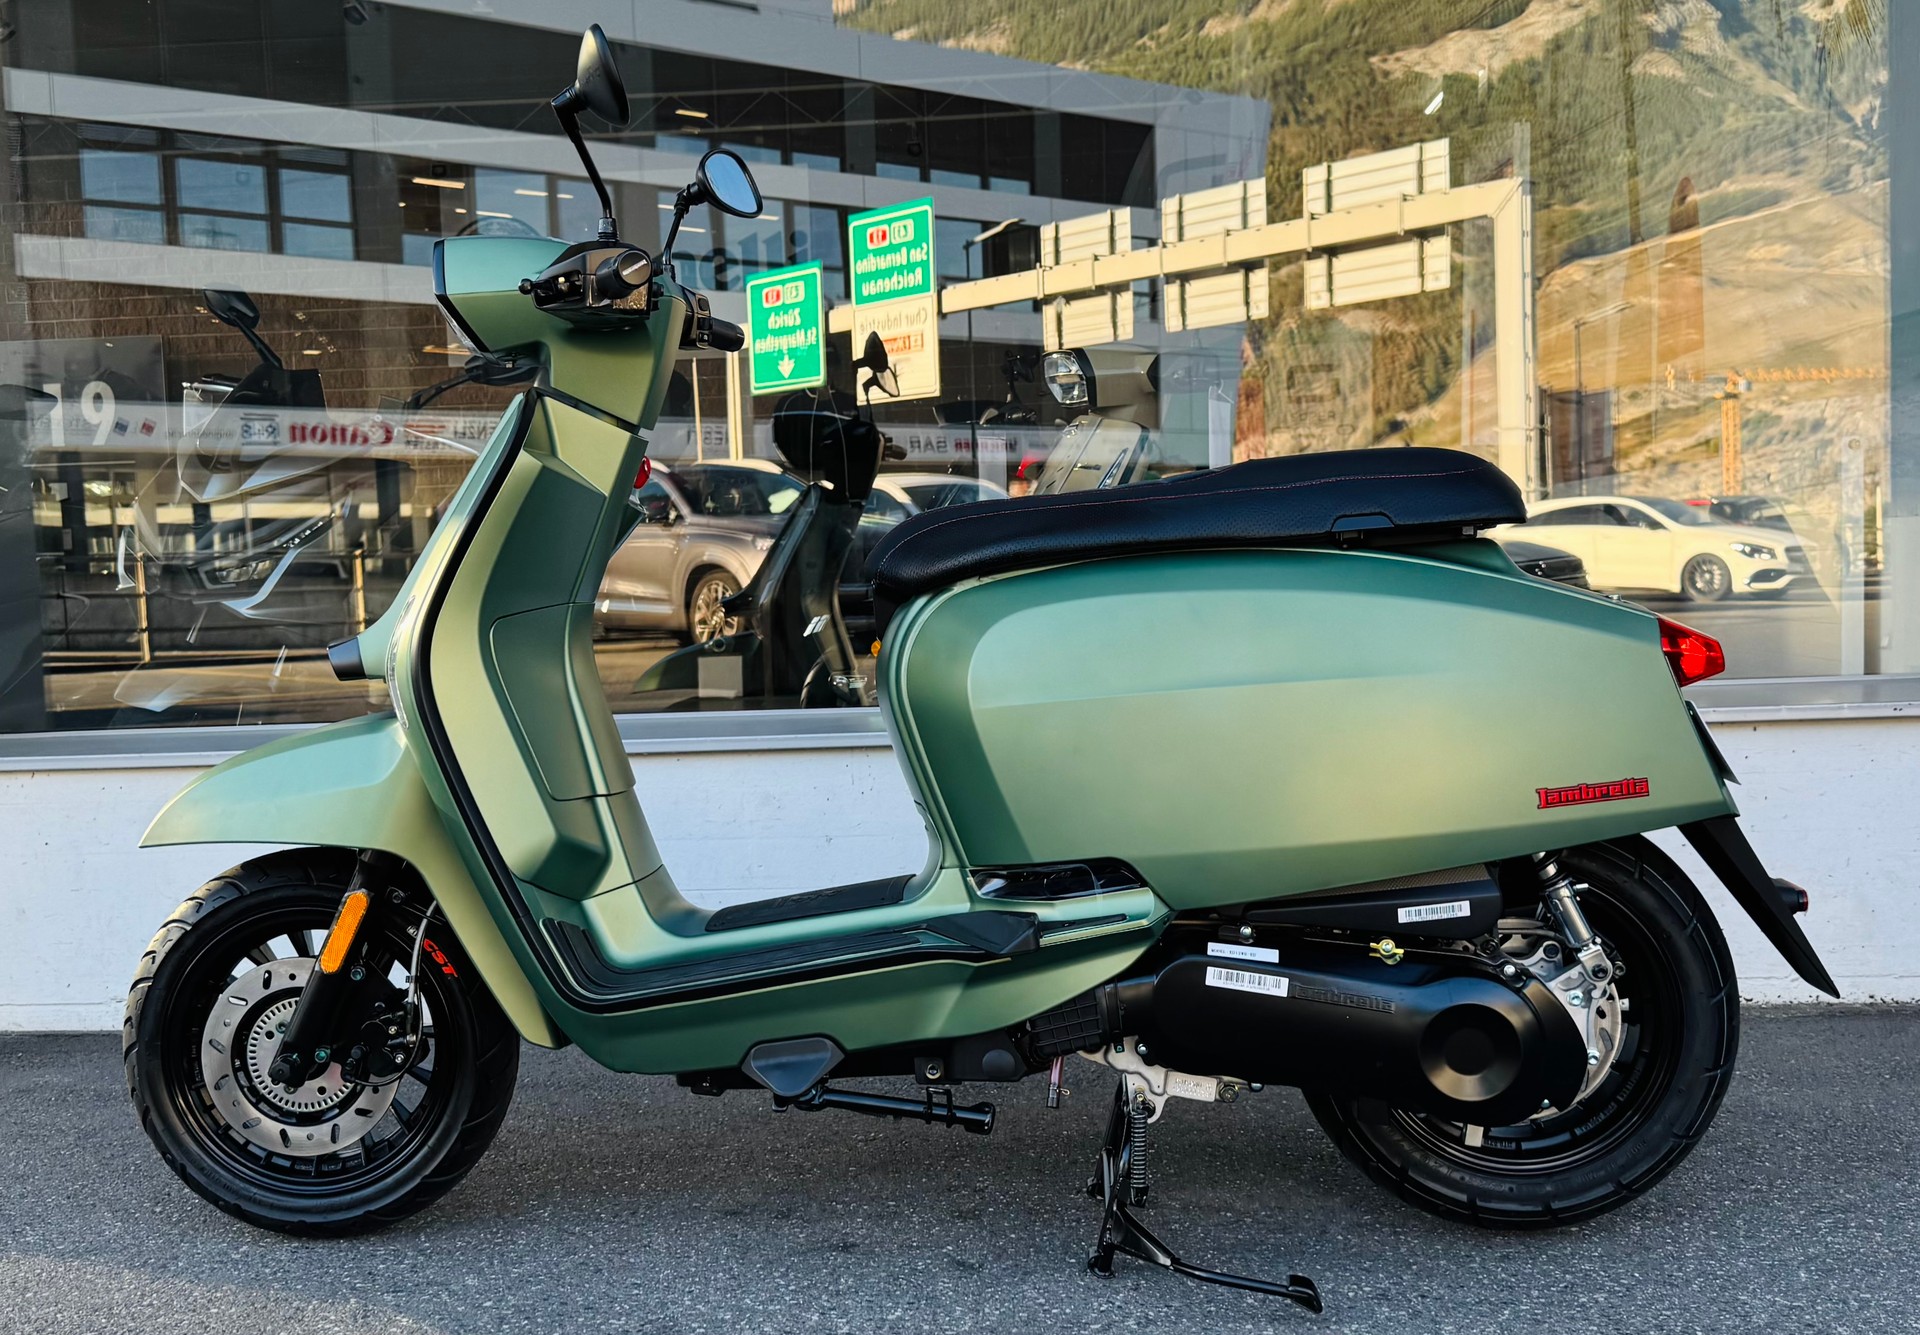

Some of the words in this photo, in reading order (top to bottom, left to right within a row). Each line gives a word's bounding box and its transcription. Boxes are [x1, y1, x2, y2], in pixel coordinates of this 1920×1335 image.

[43, 381, 116, 447] 19
[1537, 778, 1649, 809] Lambretta
[423, 938, 459, 978] CST
